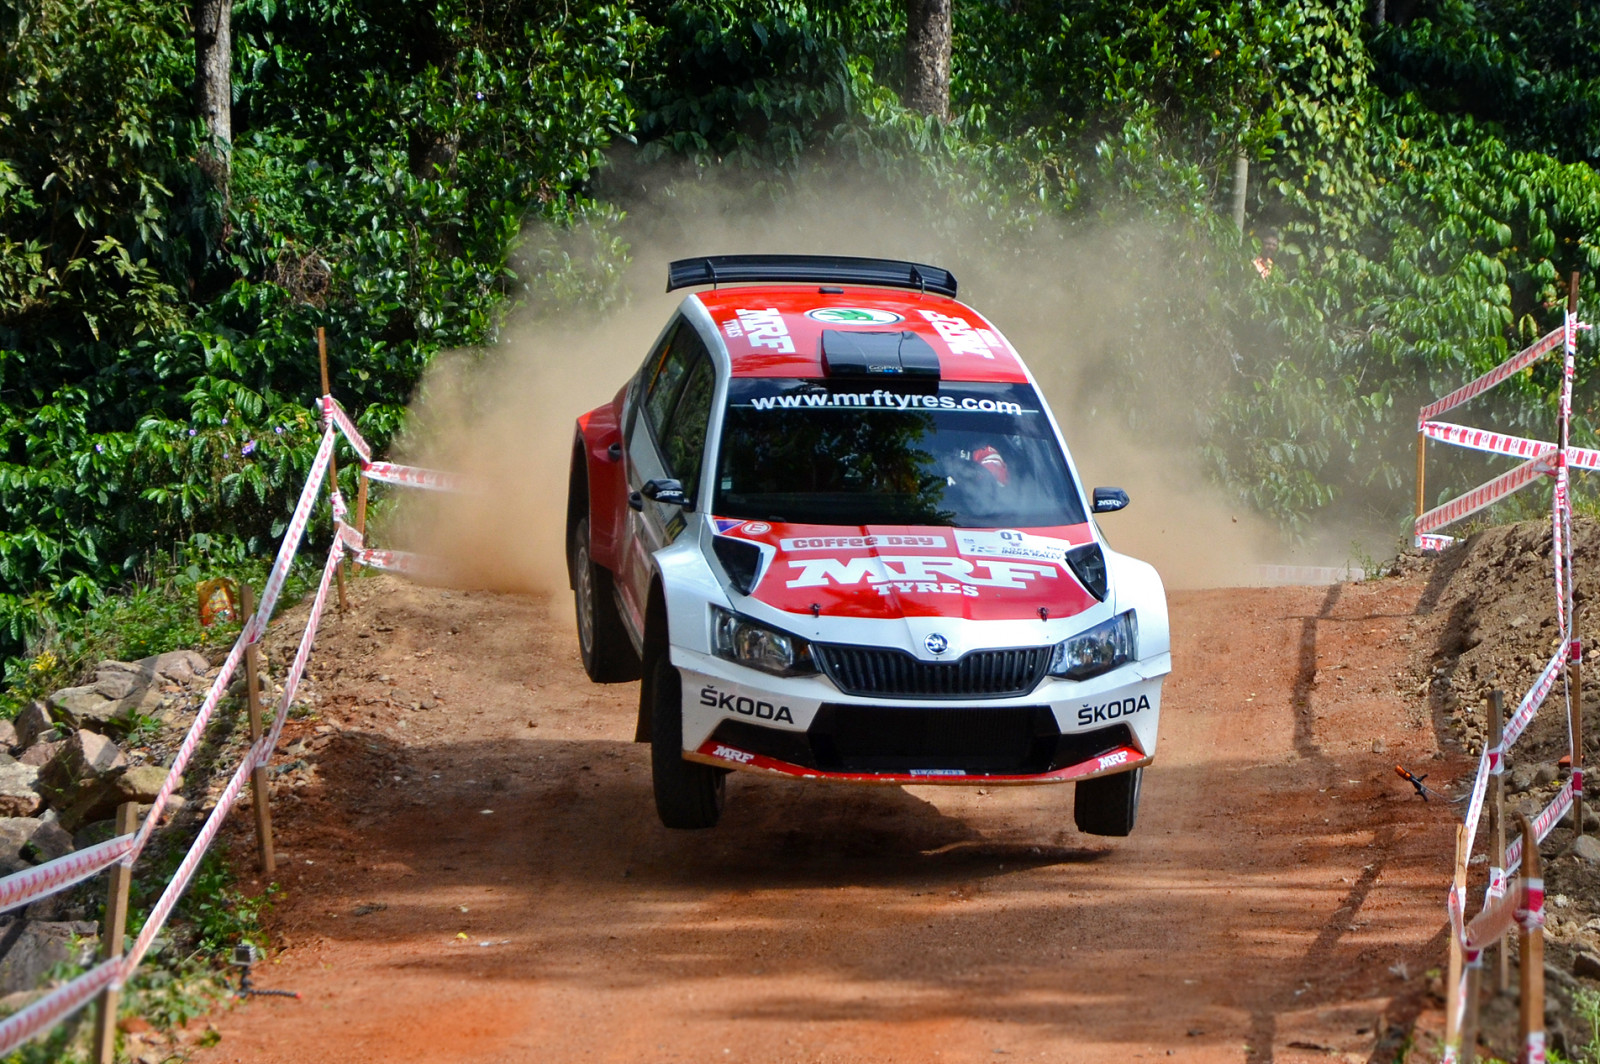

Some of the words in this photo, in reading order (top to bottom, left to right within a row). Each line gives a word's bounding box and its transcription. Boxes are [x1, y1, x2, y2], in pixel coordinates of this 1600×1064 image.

[735, 308, 796, 353] MRF
[917, 310, 995, 359] MRF
[751, 390, 1021, 415] www.mrftyres.com
[1000, 531, 1023, 541] 01
[786, 556, 1057, 588] MRF
[872, 582, 979, 597] TYRES
[700, 685, 795, 724] ŠKODA
[1077, 694, 1151, 726] ŠKODA
[712, 745, 755, 763] MRF
[1097, 750, 1129, 770] MRF
